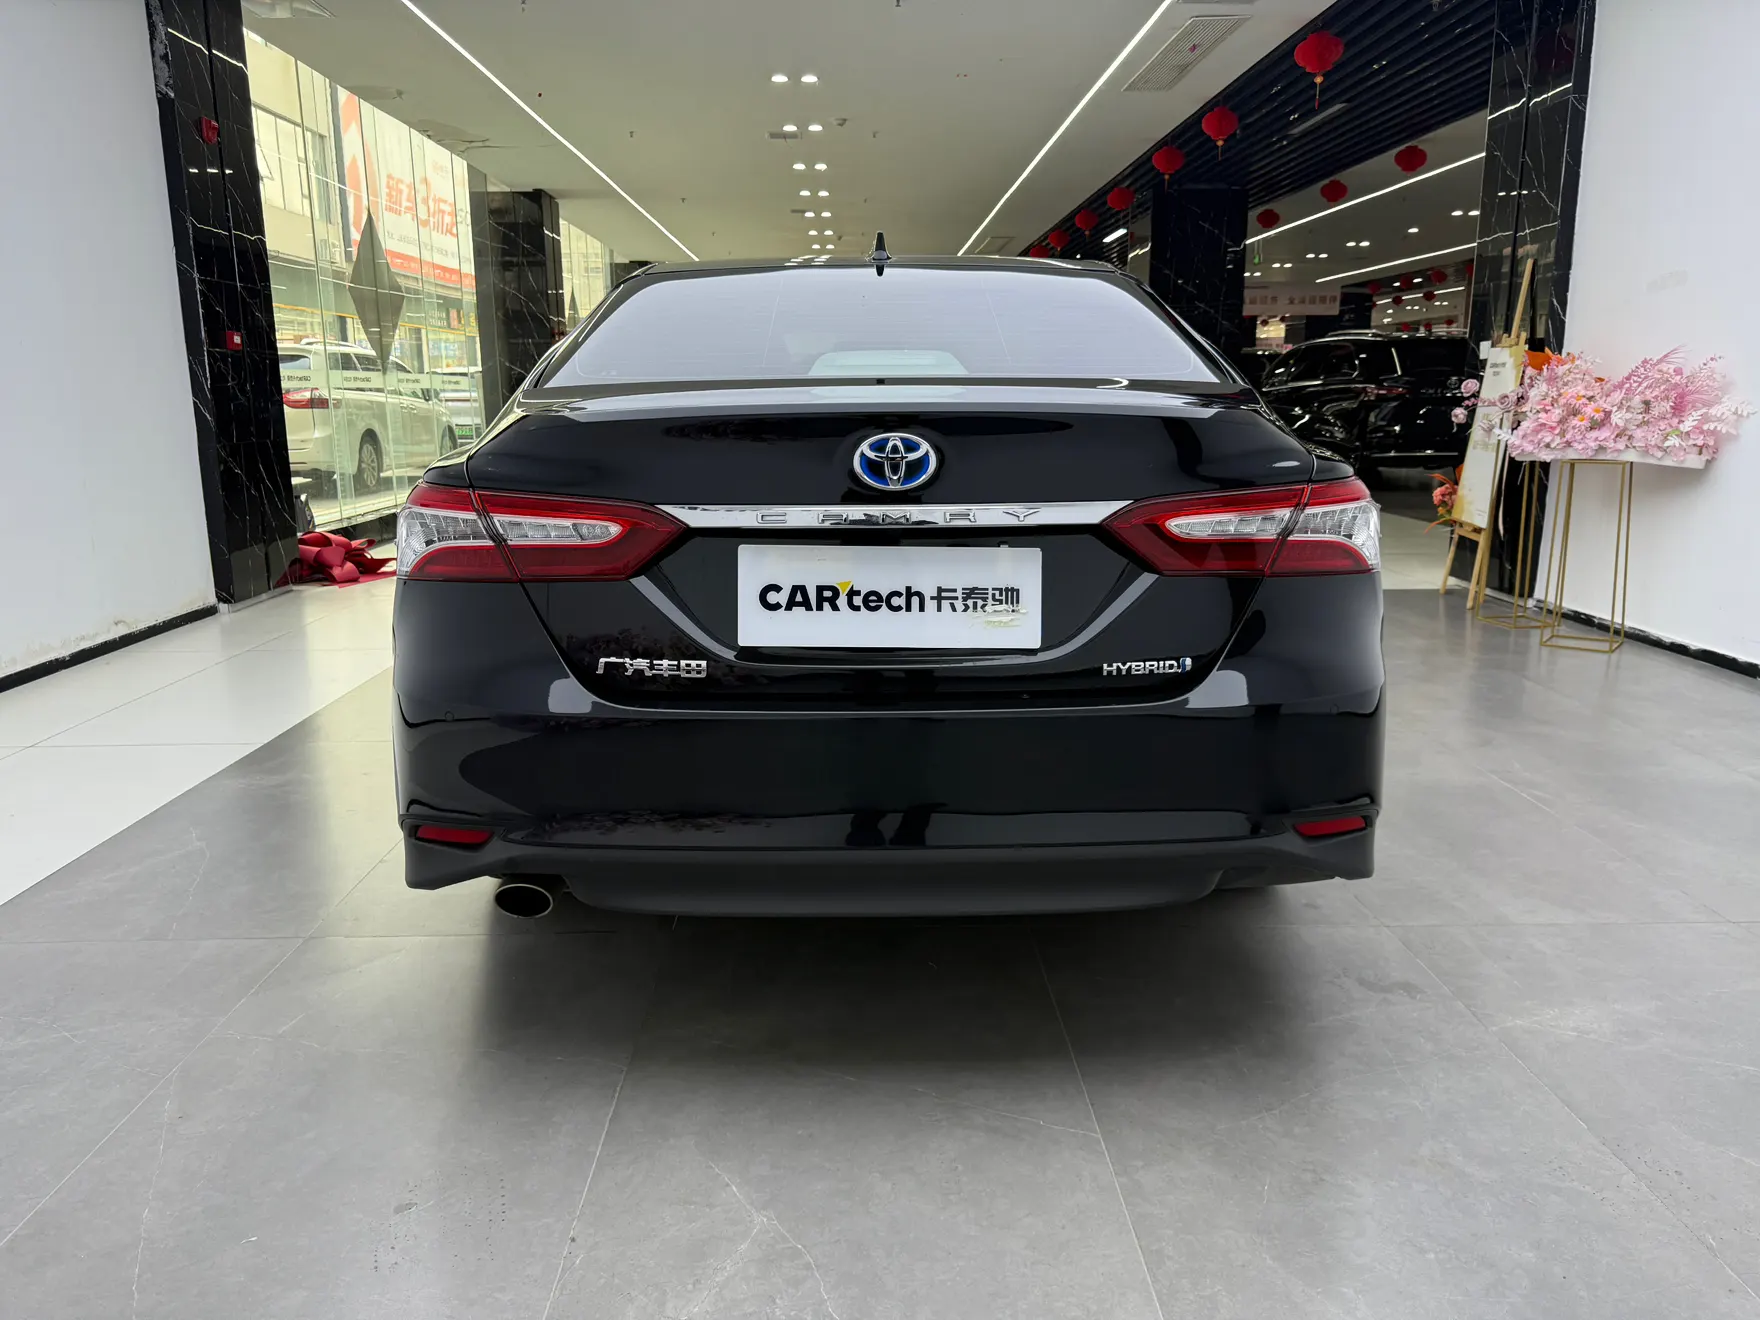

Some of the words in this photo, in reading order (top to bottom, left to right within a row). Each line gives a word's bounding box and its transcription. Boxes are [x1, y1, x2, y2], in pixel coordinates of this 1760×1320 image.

[756, 508, 1041, 524] CAMRY
[596, 657, 707, 678] 广汽丰田
[1102, 660, 1178, 676] HYBRID
